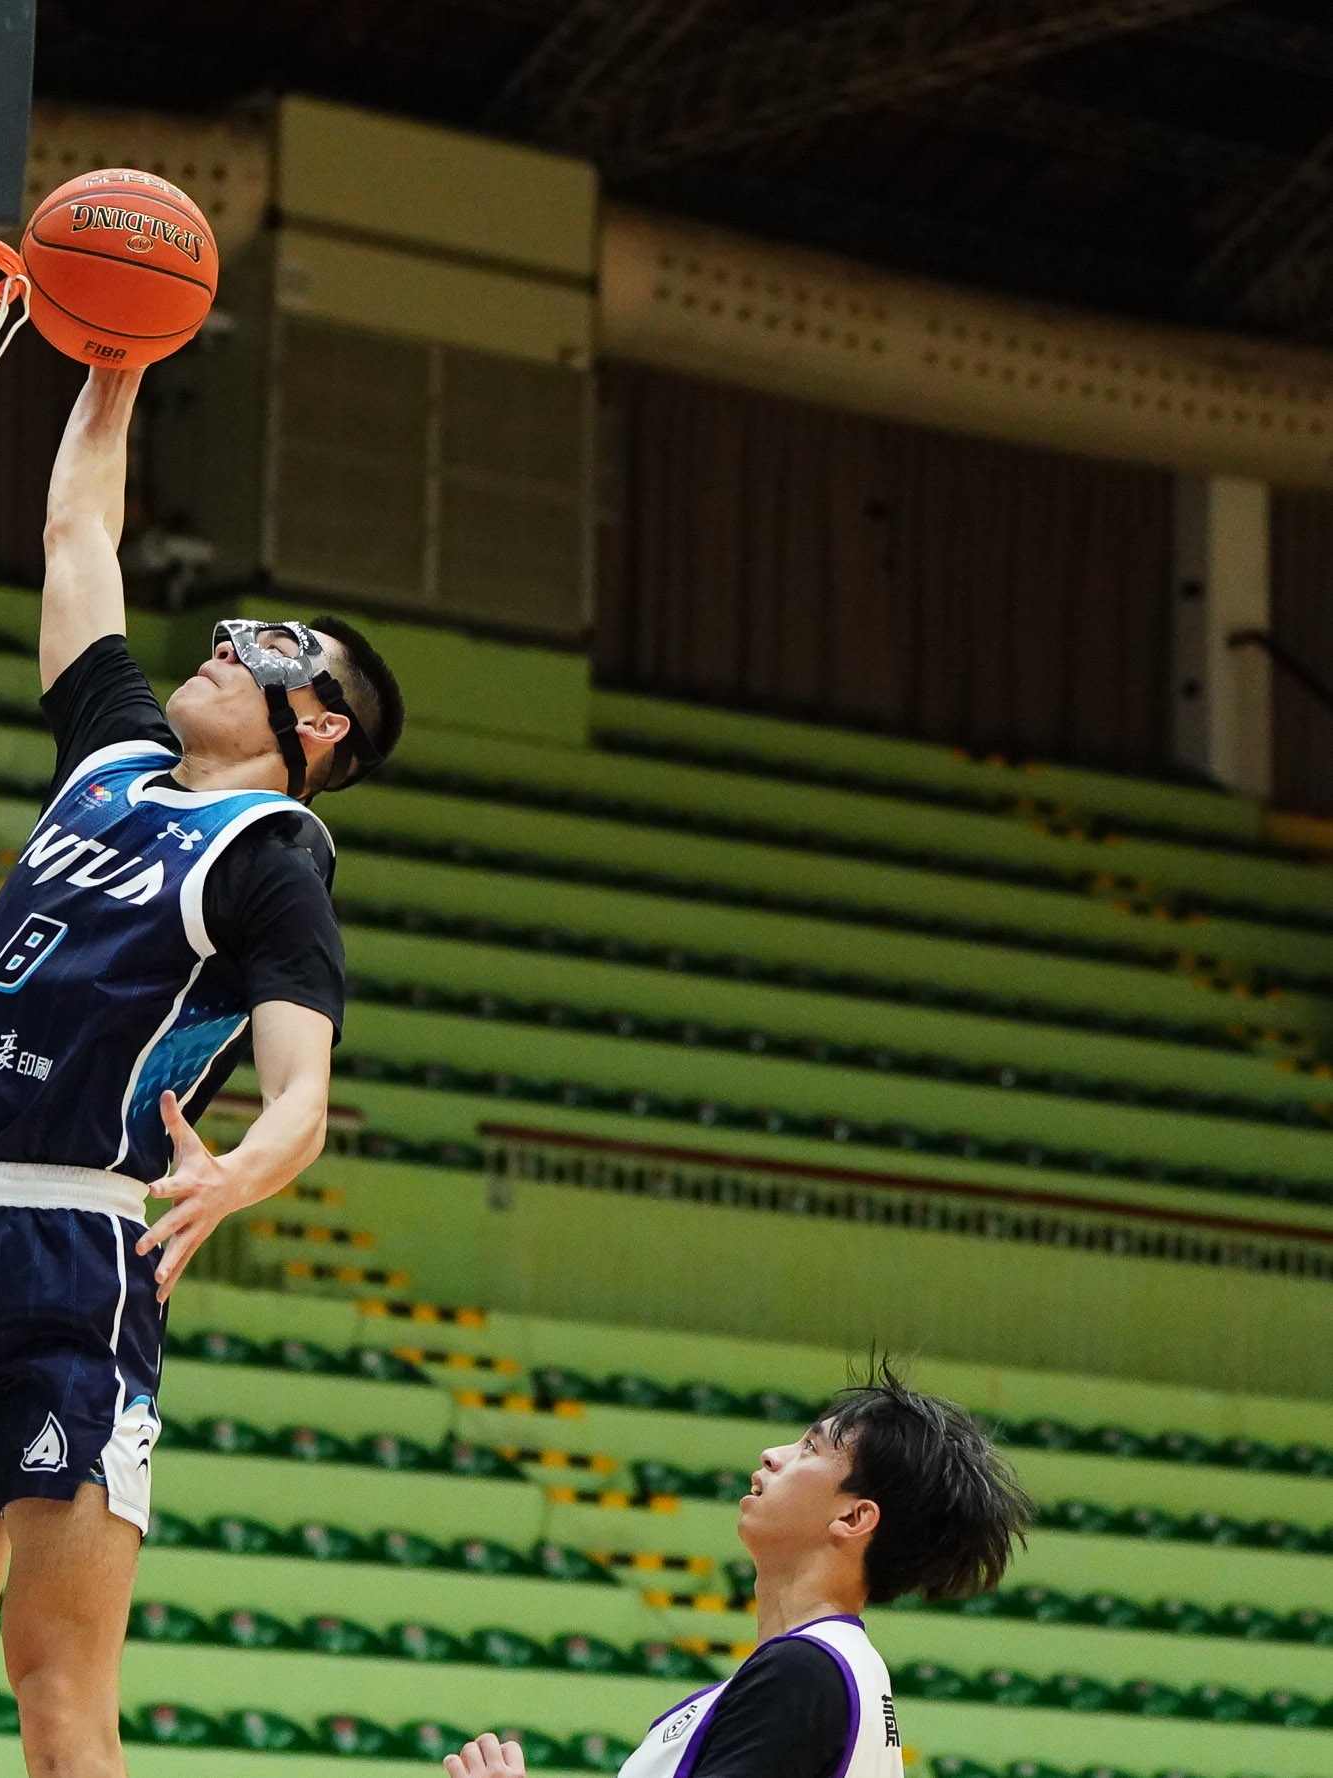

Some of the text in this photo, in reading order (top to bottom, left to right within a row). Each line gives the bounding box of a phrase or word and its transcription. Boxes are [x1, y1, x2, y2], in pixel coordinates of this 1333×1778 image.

[70, 204, 204, 264] SPALDING
[83, 340, 127, 360] FIBA
[18, 823, 165, 906] NTUA
